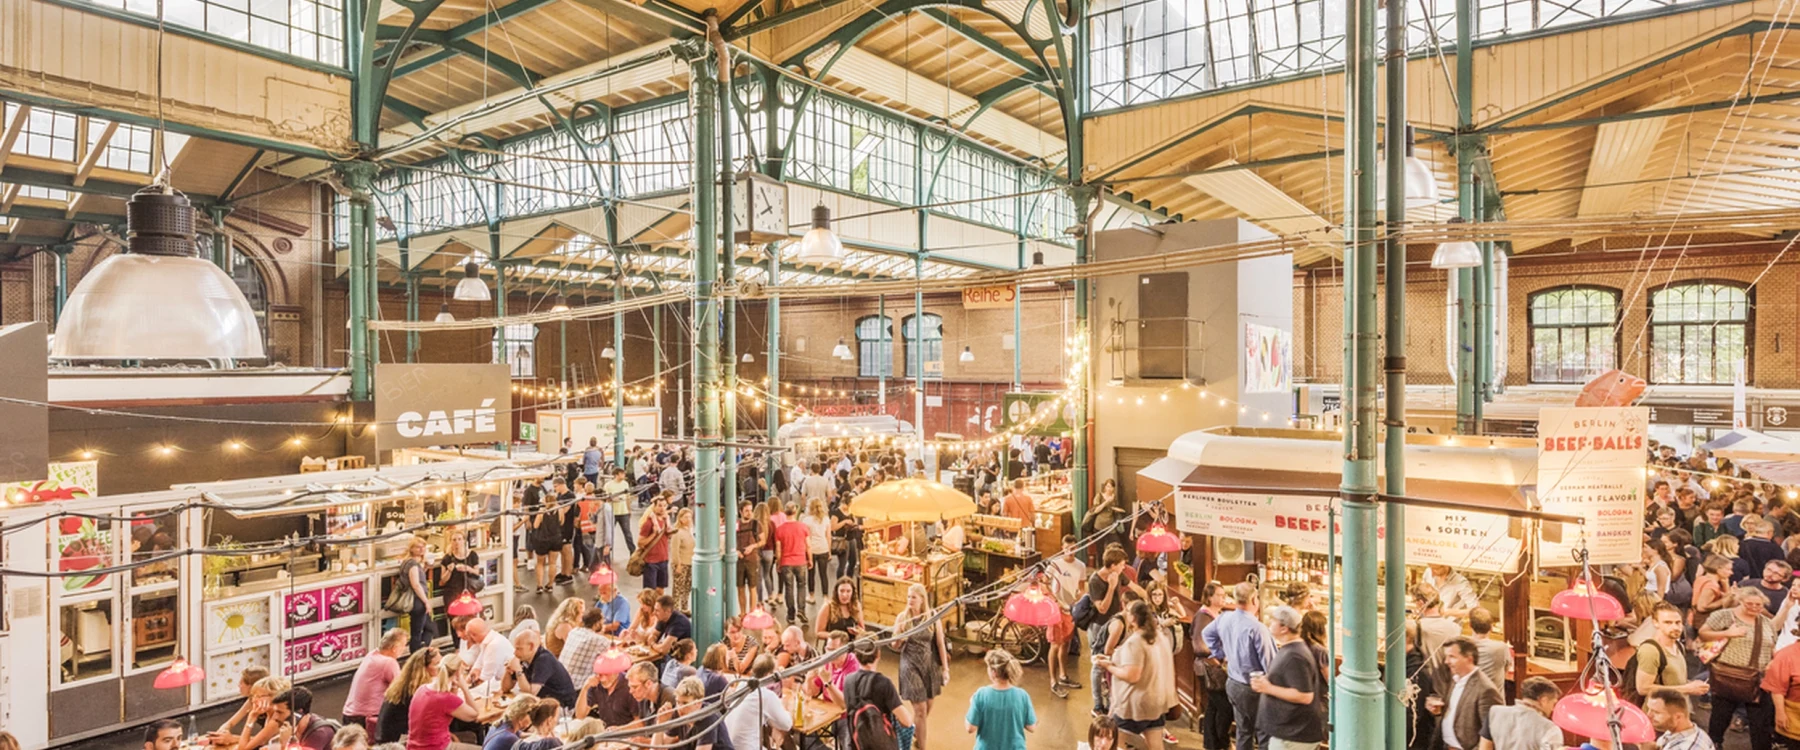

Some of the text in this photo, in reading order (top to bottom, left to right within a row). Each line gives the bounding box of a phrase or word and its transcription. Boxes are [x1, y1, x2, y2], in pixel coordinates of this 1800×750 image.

[963, 285, 1016, 303] Reihe 5
[396, 398, 496, 438] CAFÉ
[1573, 419, 1616, 429] BERLIN
[1183, 493, 1257, 507] BERLINER BOULETTEN
[1597, 494, 1637, 502] FLAVORS
[1185, 511, 1258, 526] BERLIN BOLOGNA
[1438, 526, 1487, 537] SORTEN
[1405, 537, 1458, 548] ANGALORE
